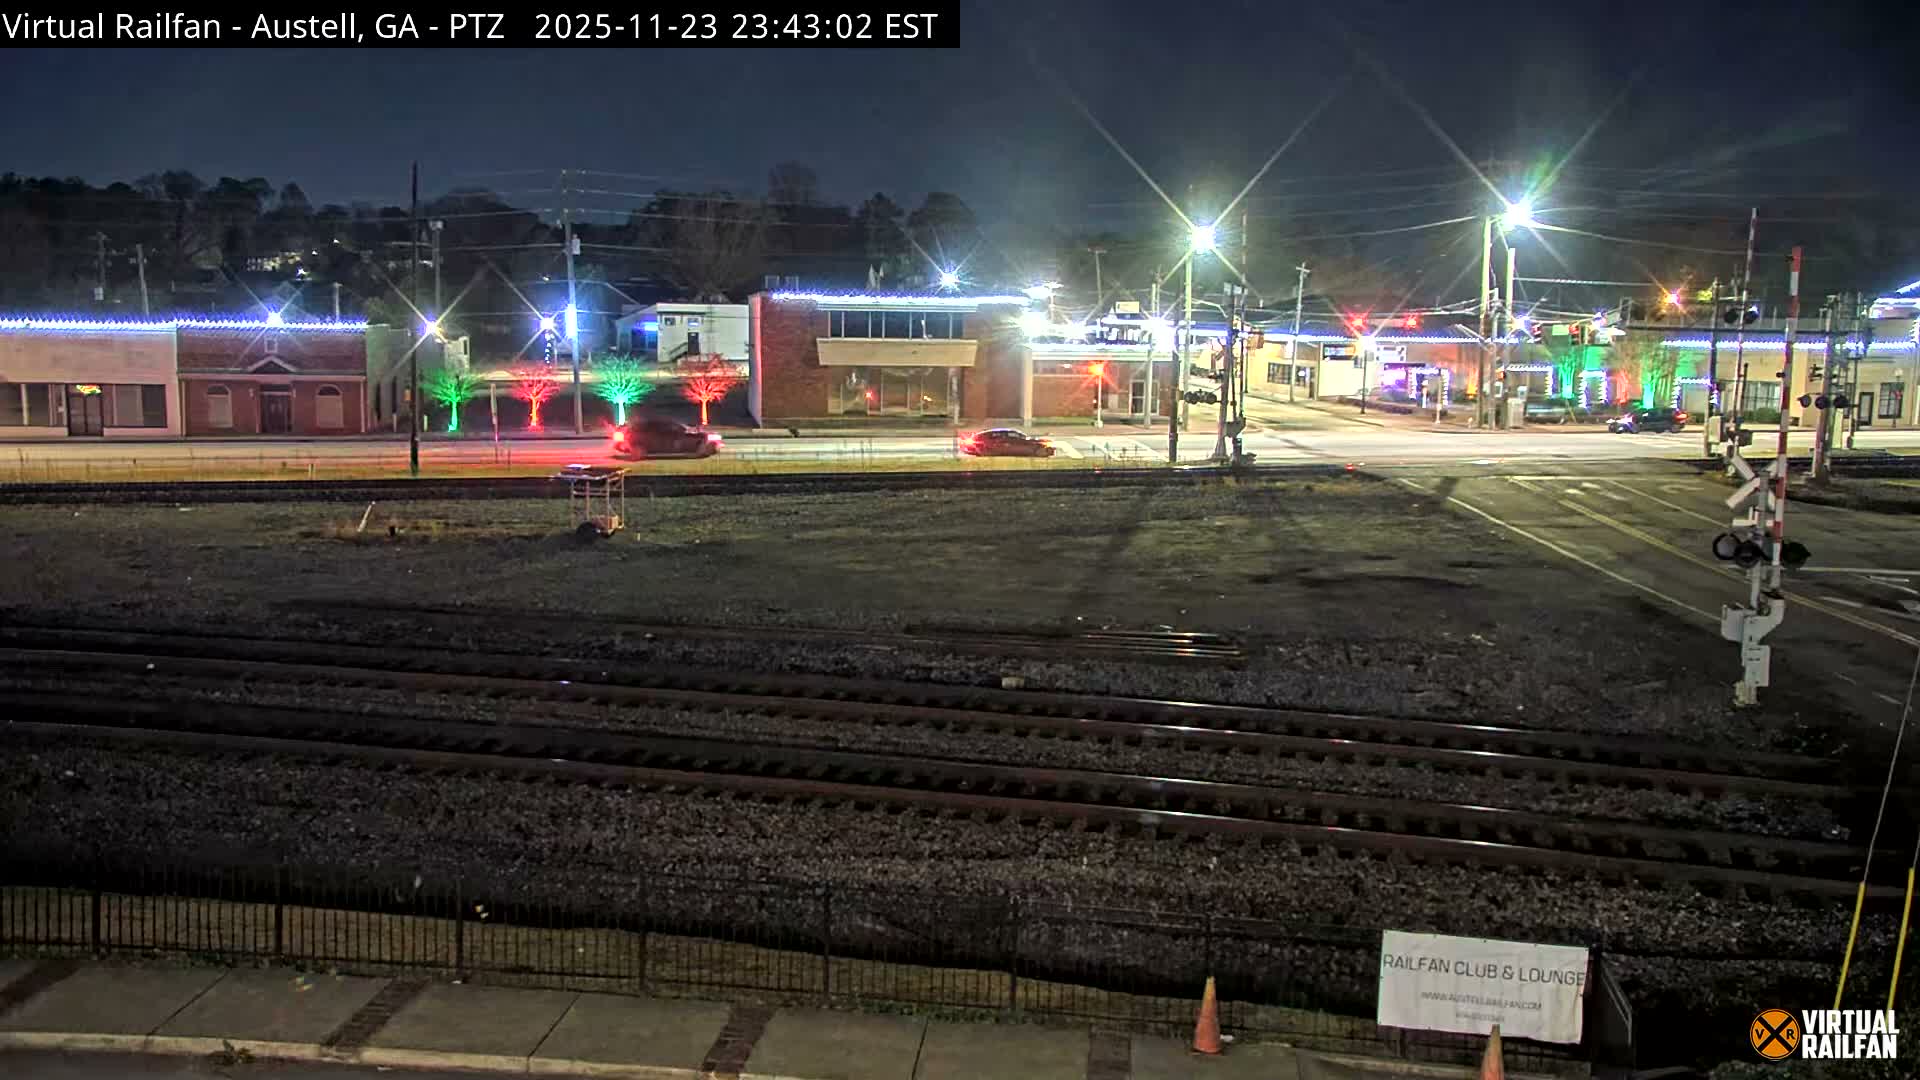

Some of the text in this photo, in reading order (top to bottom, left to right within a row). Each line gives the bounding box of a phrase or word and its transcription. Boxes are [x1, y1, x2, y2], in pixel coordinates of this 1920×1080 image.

[1383, 954, 1585, 986] RAILFAN CLUB & LOUNGE
